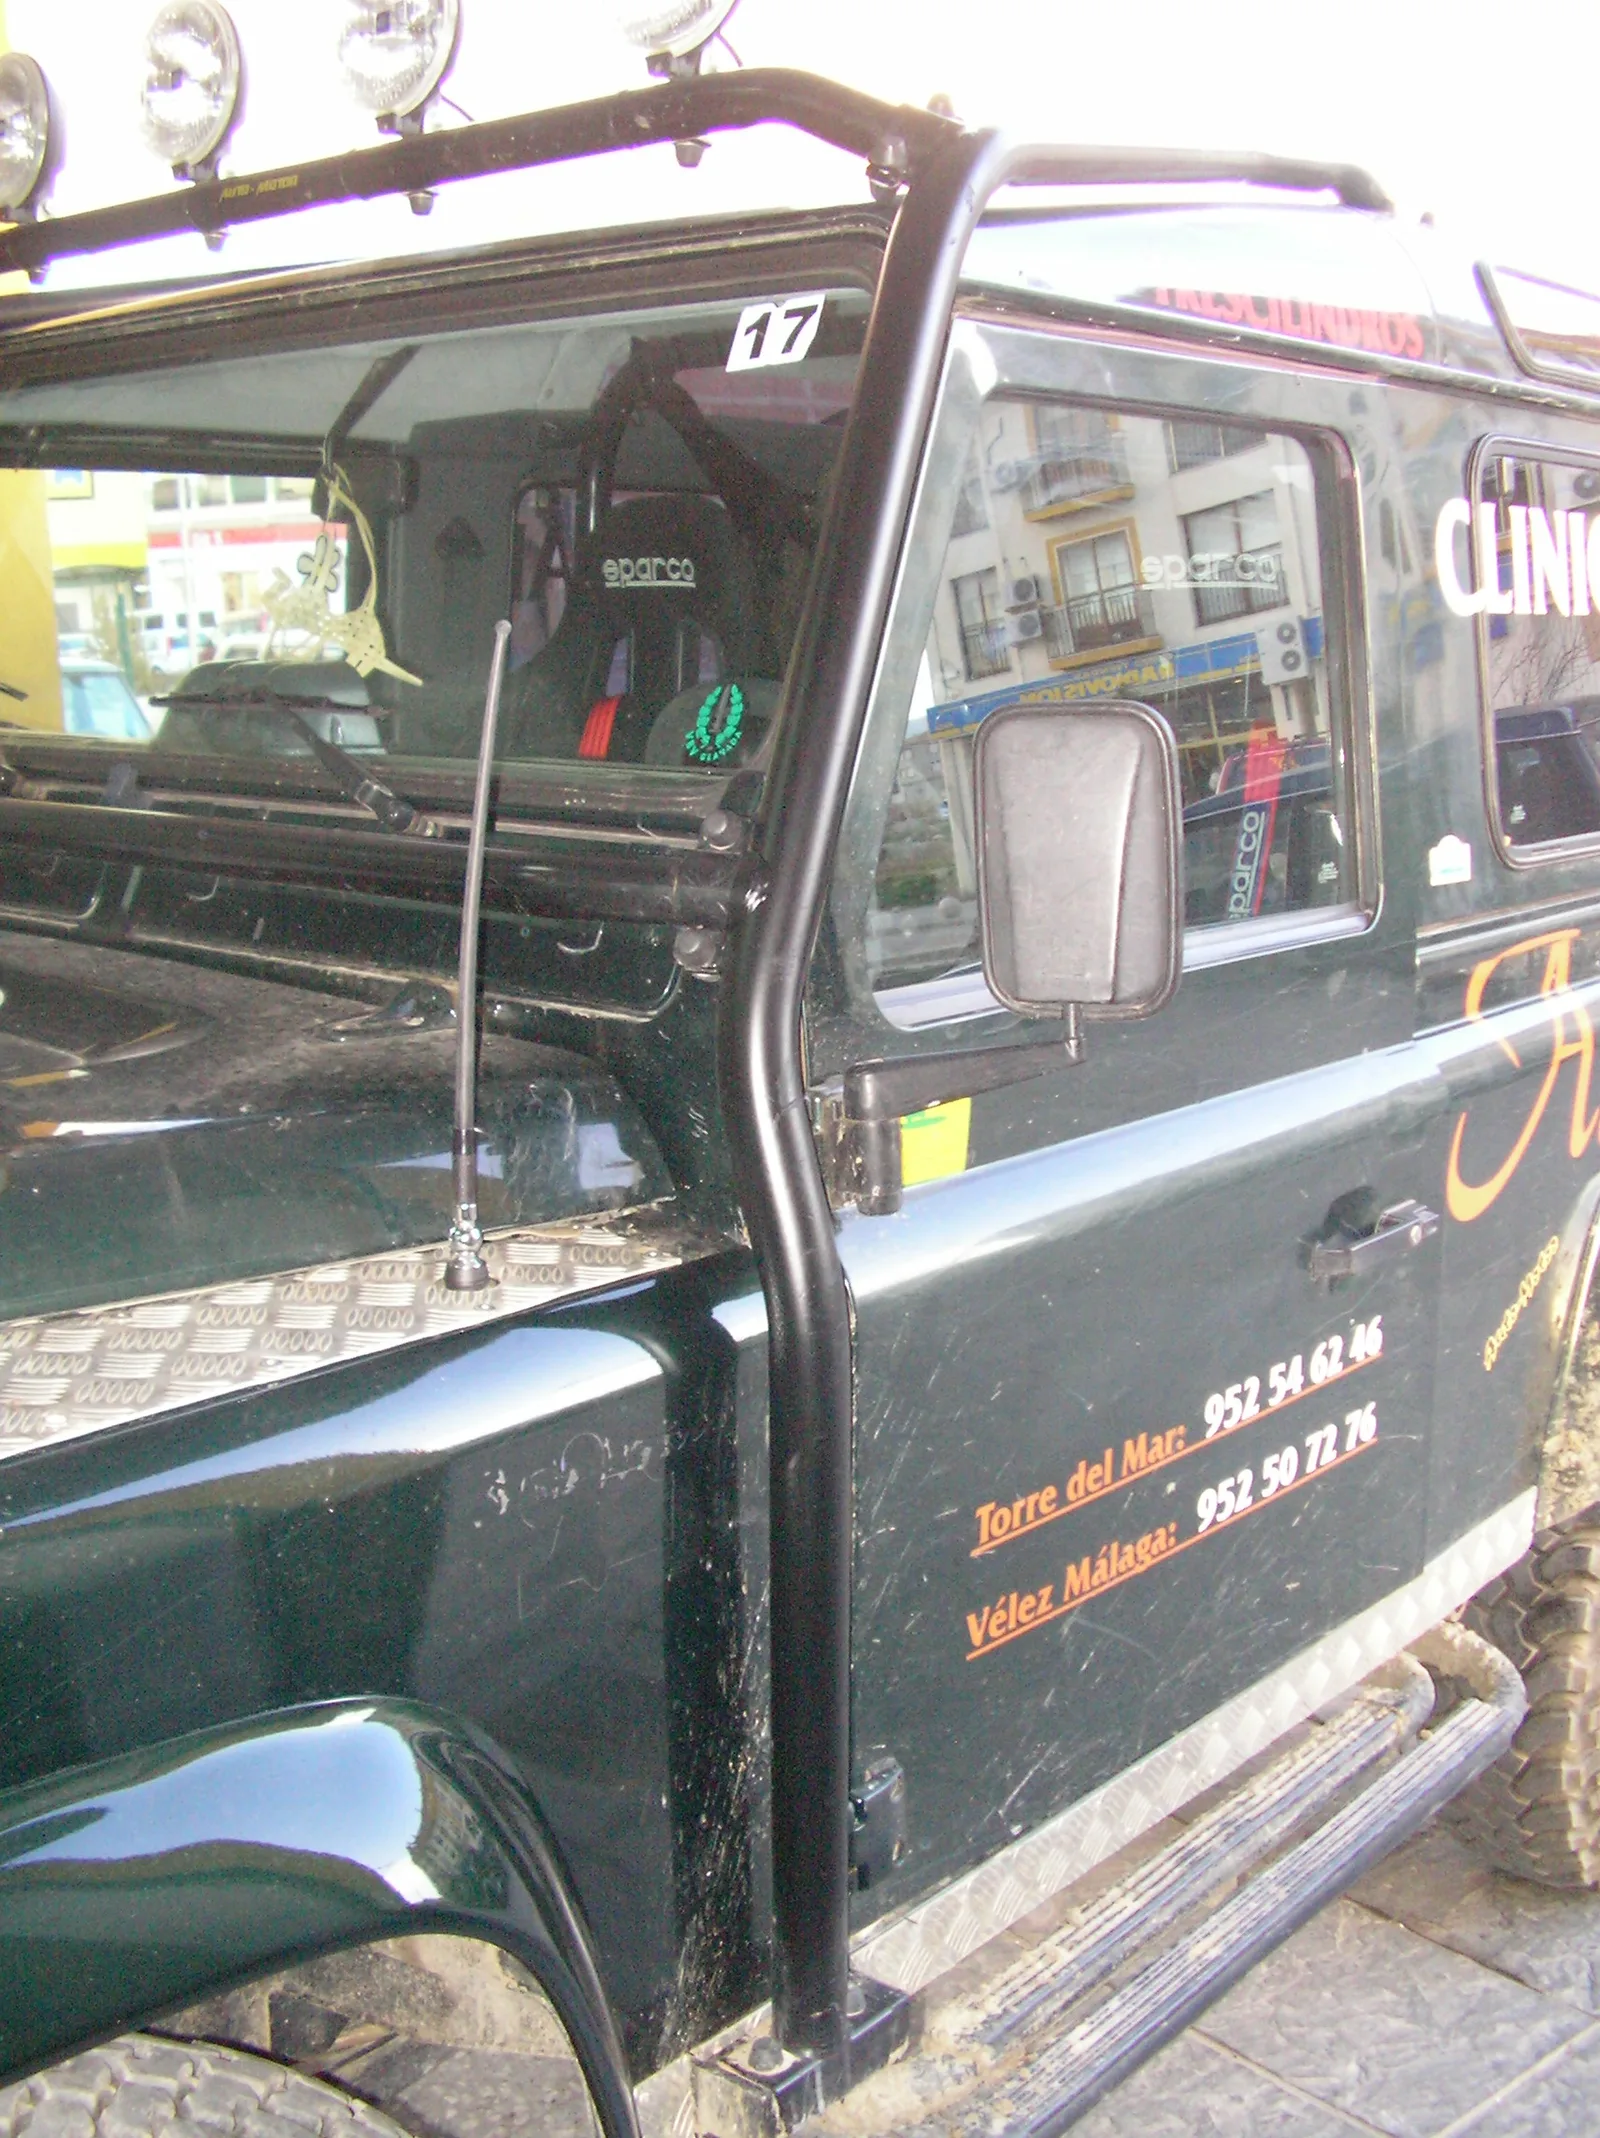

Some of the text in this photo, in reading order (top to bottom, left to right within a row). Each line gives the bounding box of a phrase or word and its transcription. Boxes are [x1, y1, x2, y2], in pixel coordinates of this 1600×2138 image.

[743, 304, 819, 360] 17
[602, 557, 696, 588] sparco
[1141, 553, 1277, 590] sparco
[1228, 810, 1264, 919] parco
[975, 1314, 1383, 1546] Torre del Mar: 952 54 62 46
[966, 1400, 1378, 1647] Vélez Málaga: 952 50 72 76
